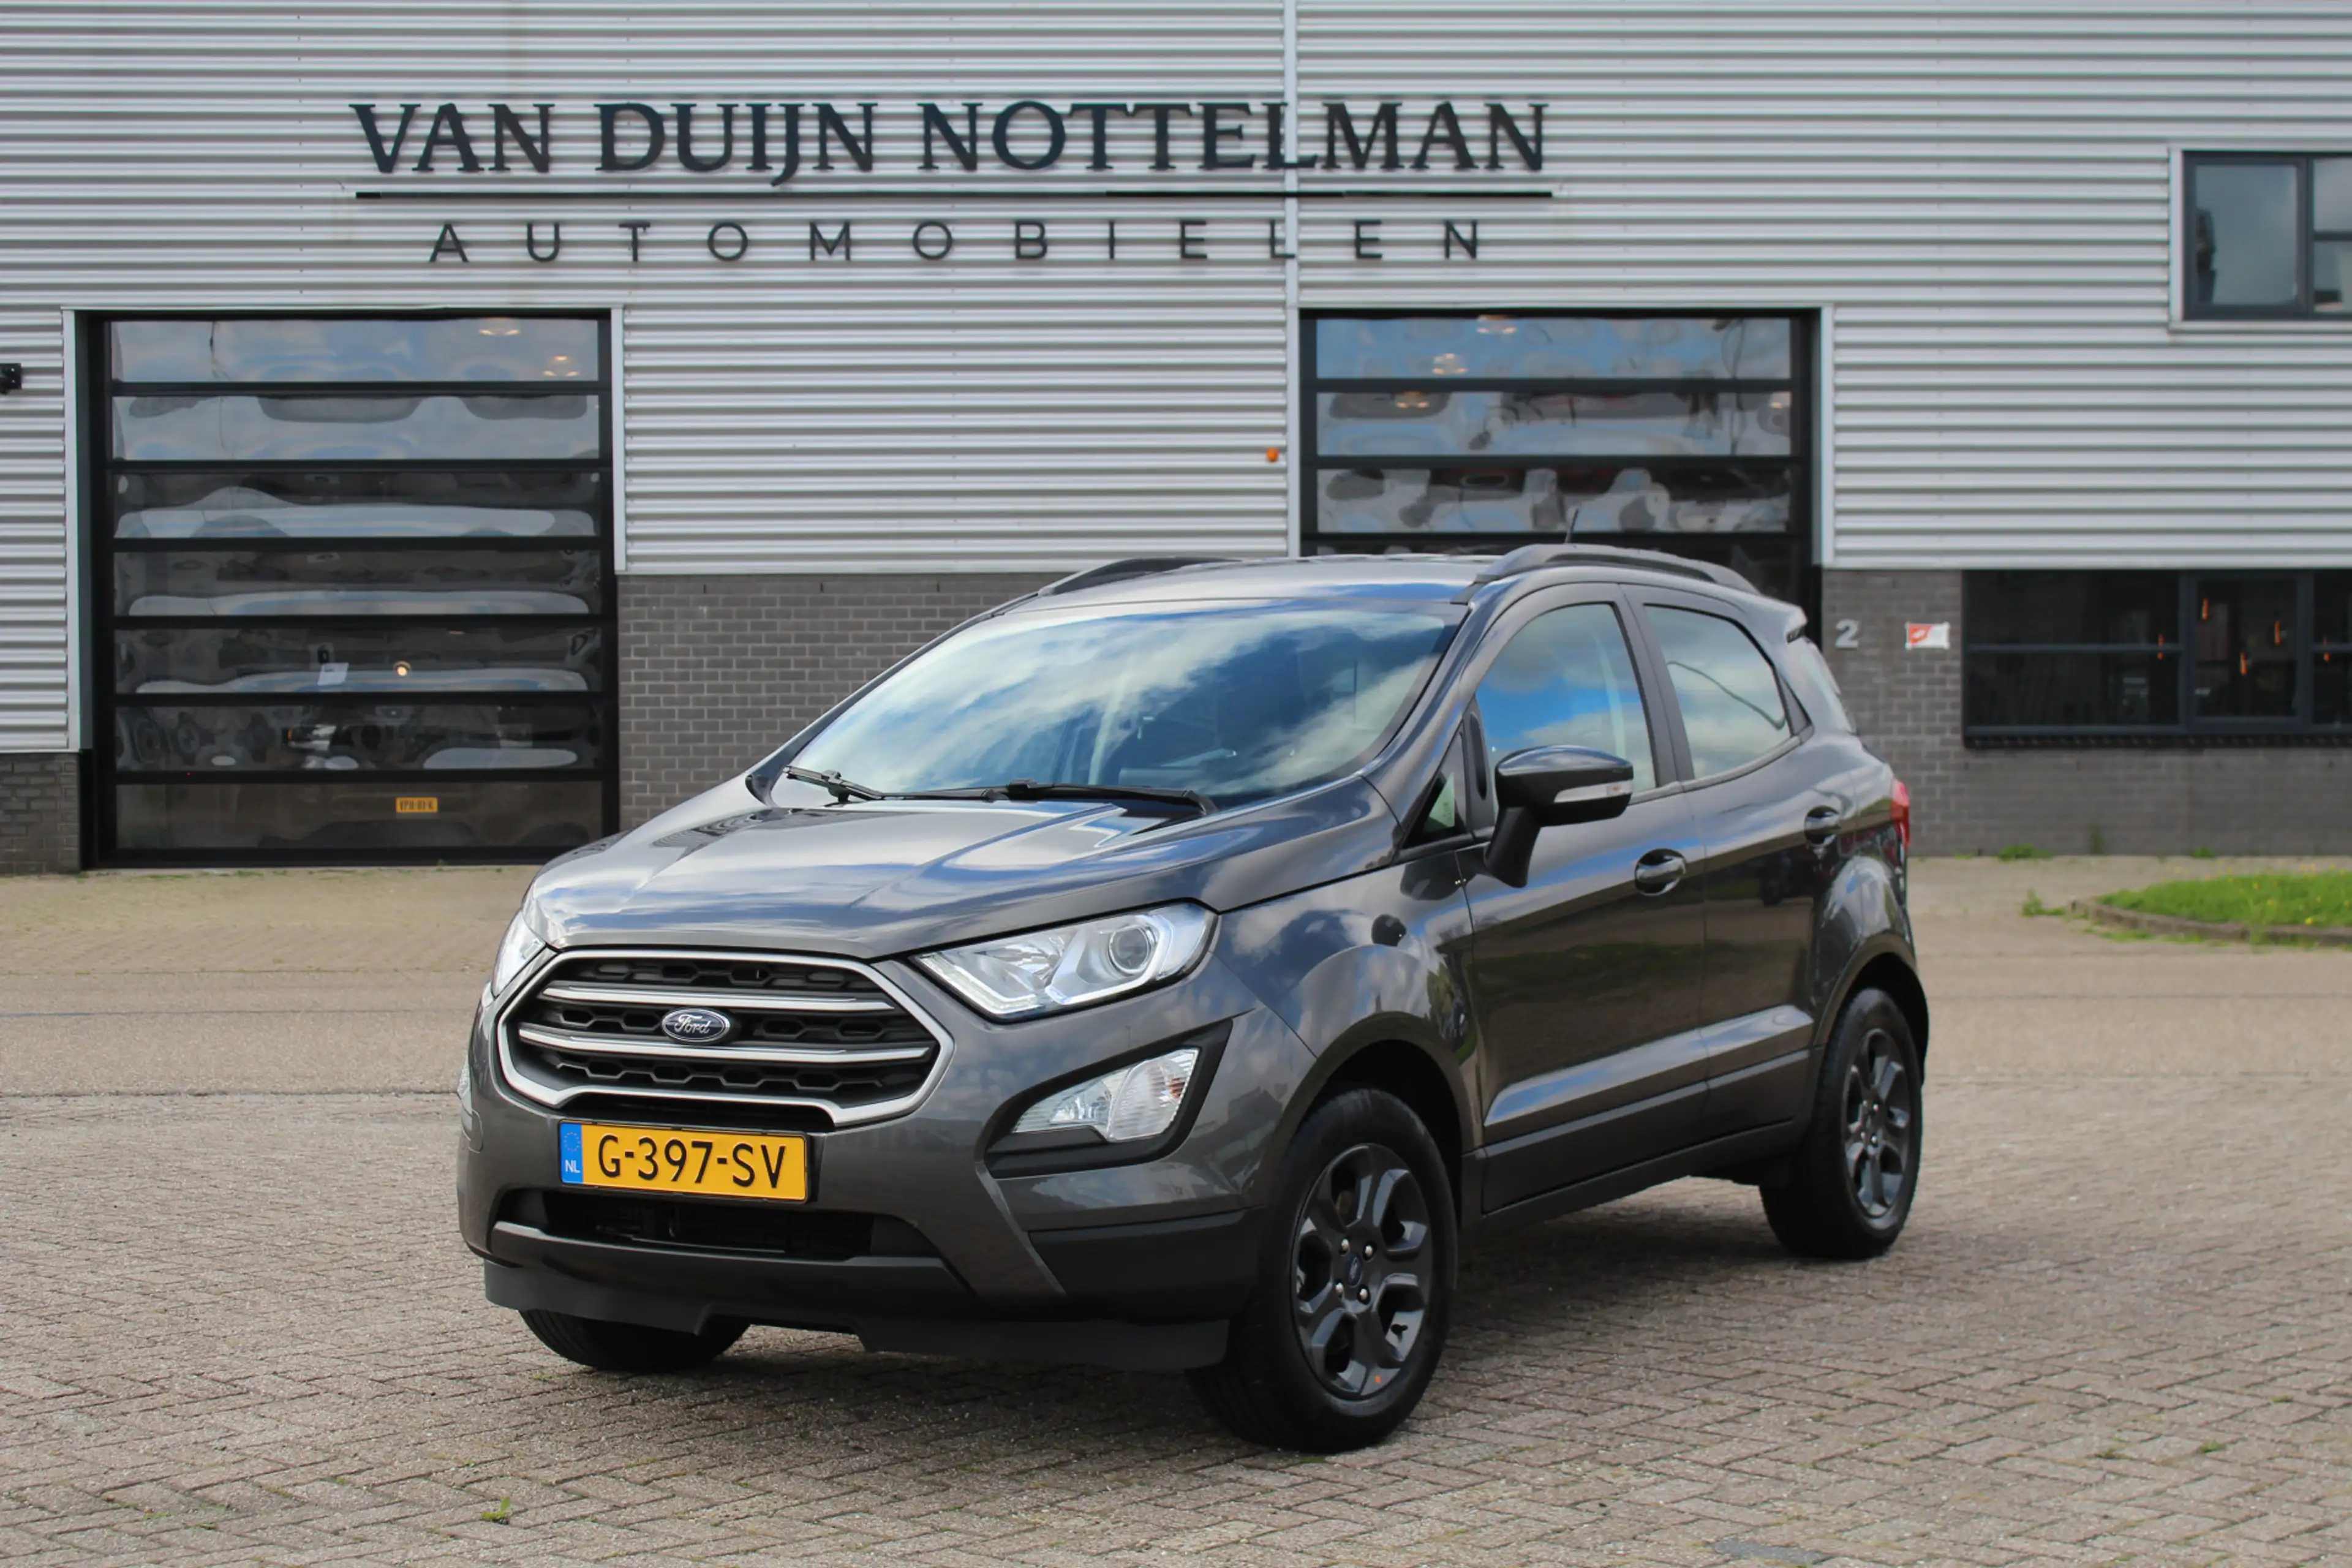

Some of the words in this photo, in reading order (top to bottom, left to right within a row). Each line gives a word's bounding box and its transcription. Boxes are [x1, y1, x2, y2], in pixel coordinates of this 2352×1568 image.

[348, 102, 554, 173] VAN
[593, 102, 878, 187] DUIJN
[917, 100, 1548, 172] NOTTELMAN
[428, 220, 1478, 263] AUTOMOBIELEN
[1834, 619, 1859, 649] 2
[674, 1014, 711, 1034] Ford
[564, 1159, 581, 1174] NL
[598, 1134, 786, 1189] G-397-SV
